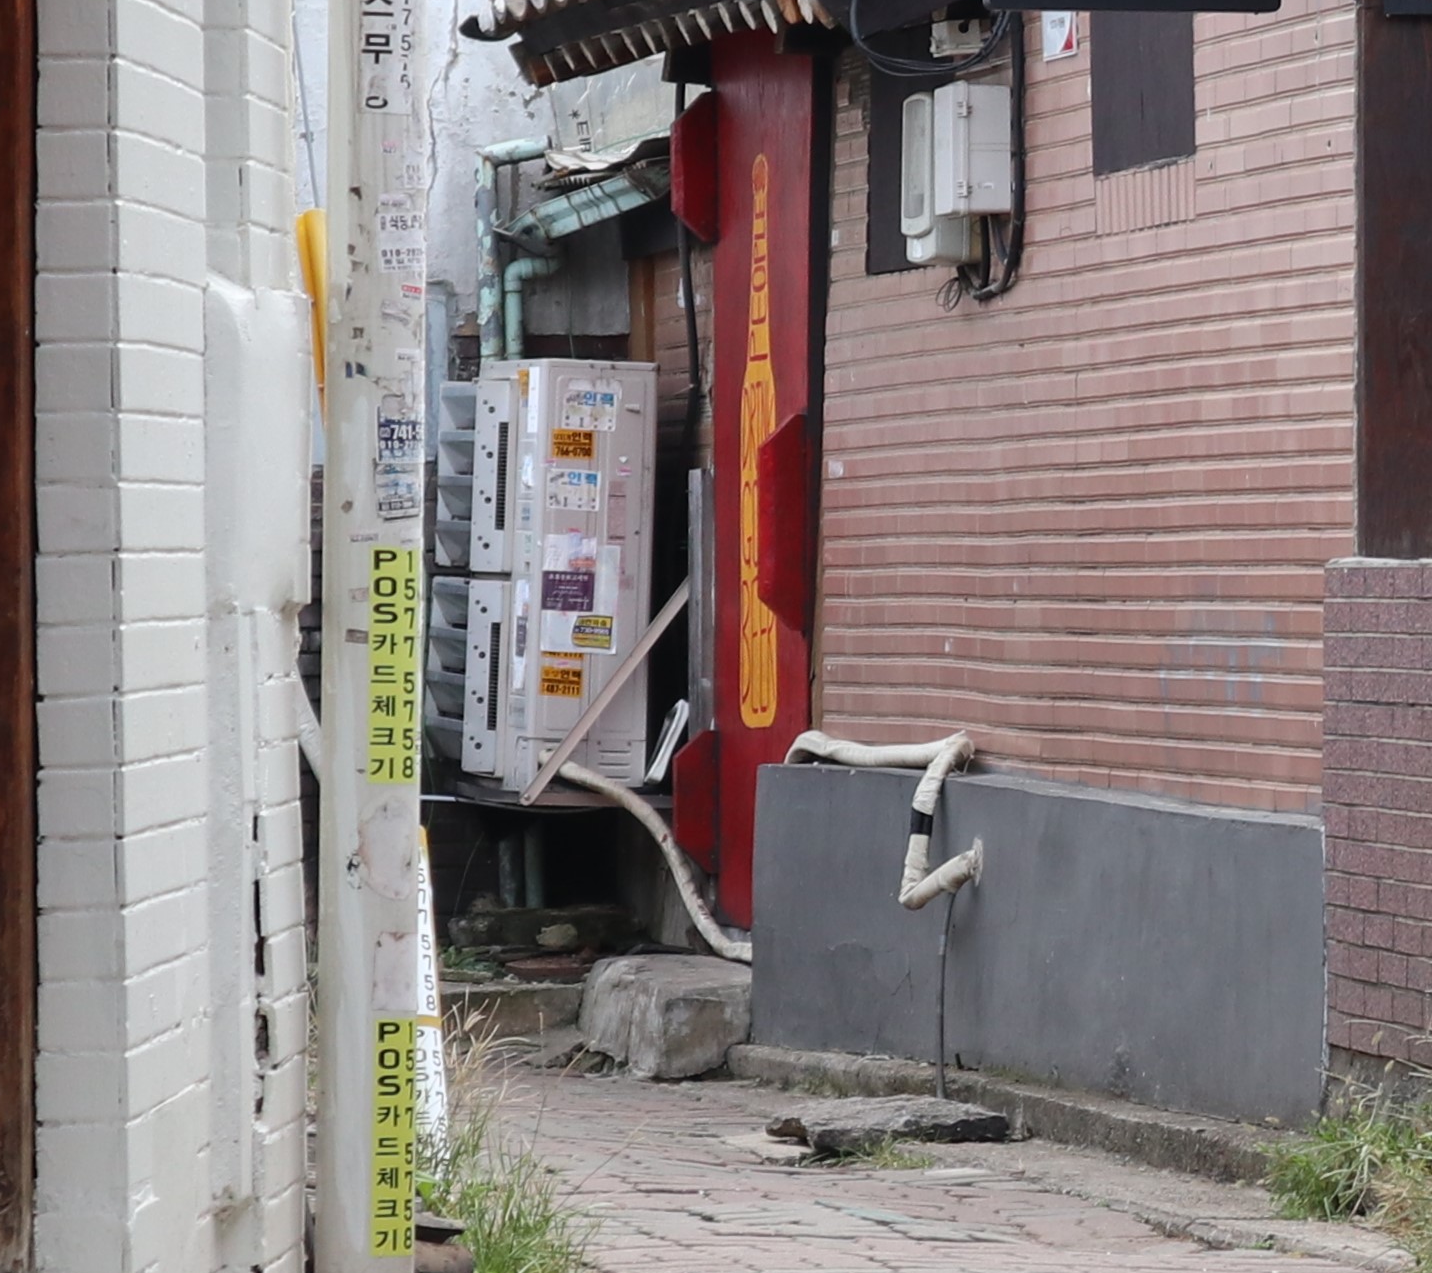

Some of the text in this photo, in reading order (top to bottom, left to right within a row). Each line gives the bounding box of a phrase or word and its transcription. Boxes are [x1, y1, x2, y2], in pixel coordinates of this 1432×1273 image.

[401, 550, 416, 779] 1577 5758
[420, 934, 436, 1012] 5758
